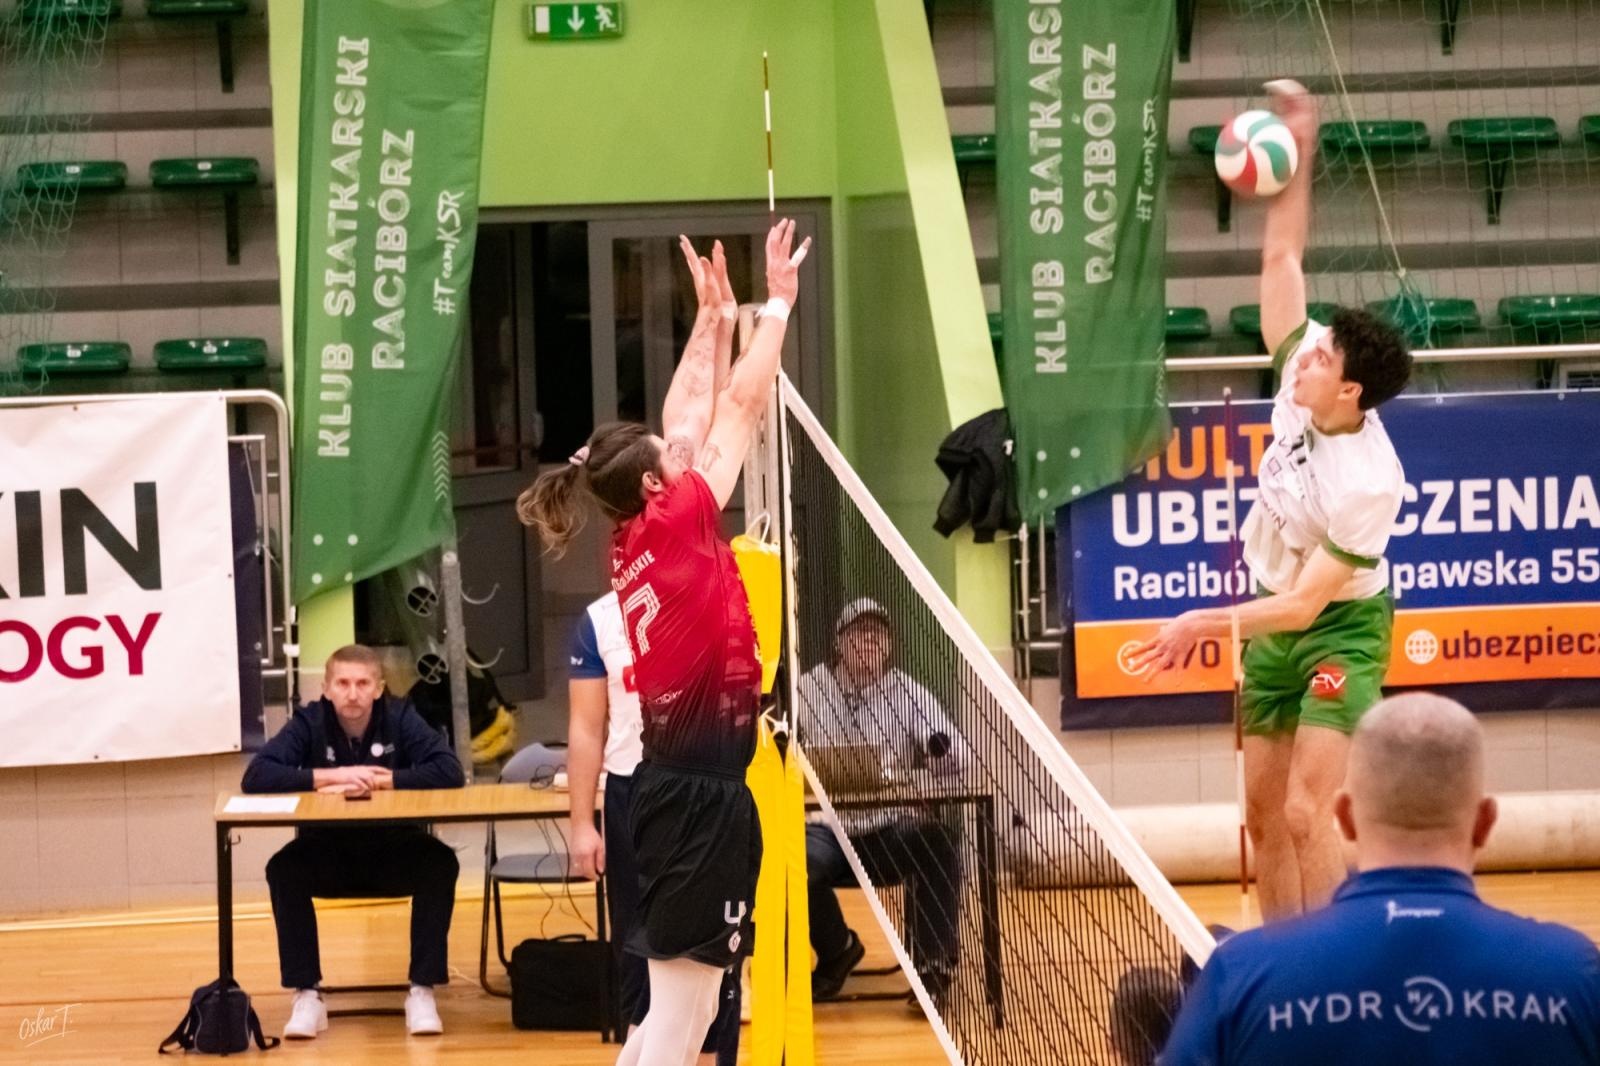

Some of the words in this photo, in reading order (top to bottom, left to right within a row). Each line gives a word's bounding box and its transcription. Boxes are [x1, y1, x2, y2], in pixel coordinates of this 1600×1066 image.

[1028, 0, 1064, 234] SIATKARS
[1071, 43, 1118, 284] RACIBÓRZ
[324, 36, 370, 317] SIATKARSKI
[367, 129, 415, 369] RACIBÓRZ
[1032, 260, 1068, 373] KLUB
[317, 342, 354, 457] KLUB
[1146, 423, 1273, 481] ULT
[0, 481, 162, 599] IN
[1384, 550, 1540, 600] pawska
[1551, 548, 1600, 584] 55
[1442, 626, 1600, 664] ubezpiec
[1269, 991, 1382, 1032] HYDR
[1462, 989, 1568, 1026] KRAK
